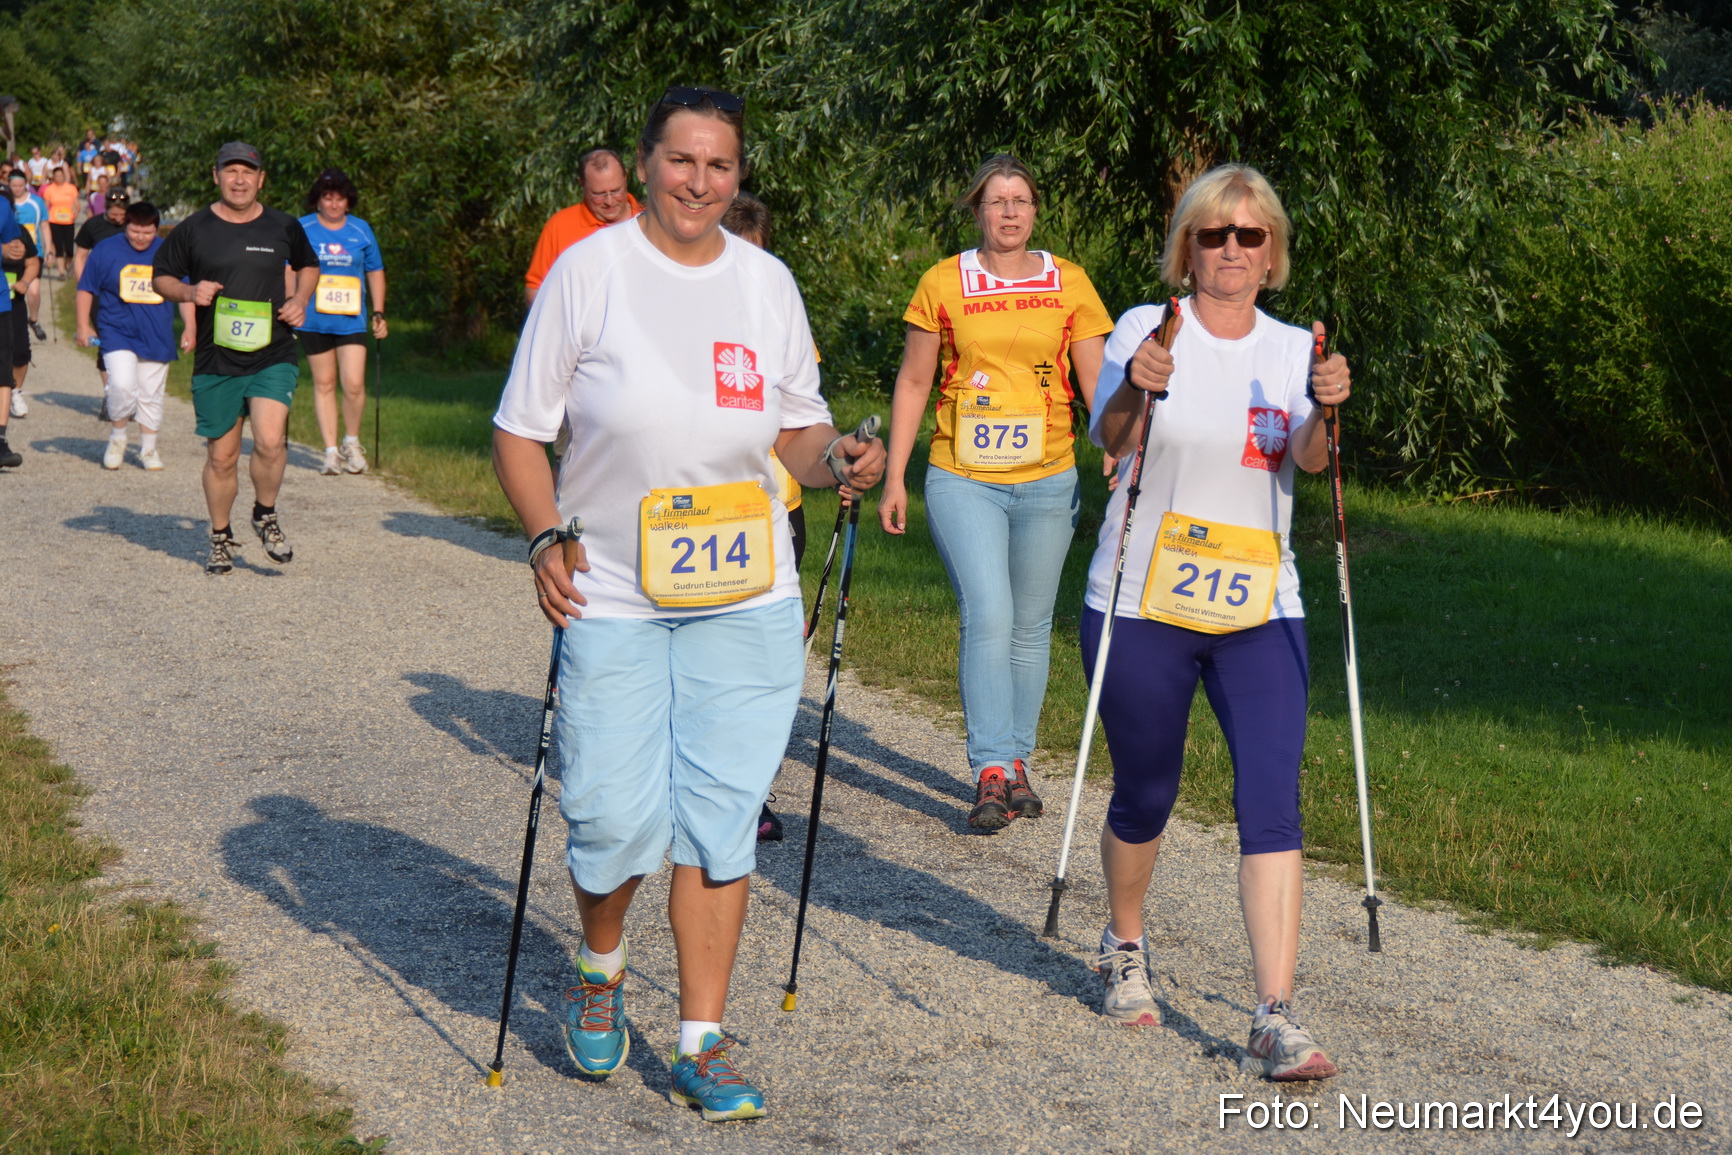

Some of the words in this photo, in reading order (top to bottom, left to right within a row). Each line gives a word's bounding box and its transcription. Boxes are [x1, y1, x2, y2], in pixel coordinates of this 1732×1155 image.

[325, 291, 350, 304] 481
[963, 299, 1009, 316] MAX
[1015, 295, 1064, 311] BÖGL
[231, 320, 255, 337] 87
[720, 394, 762, 410] caritas
[973, 423, 1029, 450] 875
[663, 506, 711, 517] firmenlauf
[1177, 533, 1223, 550] firmenlauf
[671, 531, 751, 574] 214
[673, 582, 705, 590] Gudrun
[705, 578, 748, 588] Eichenseer
[1171, 562, 1252, 607] 215
[1174, 602, 1200, 615] Christl
[1200, 608, 1236, 621] Wittmann
